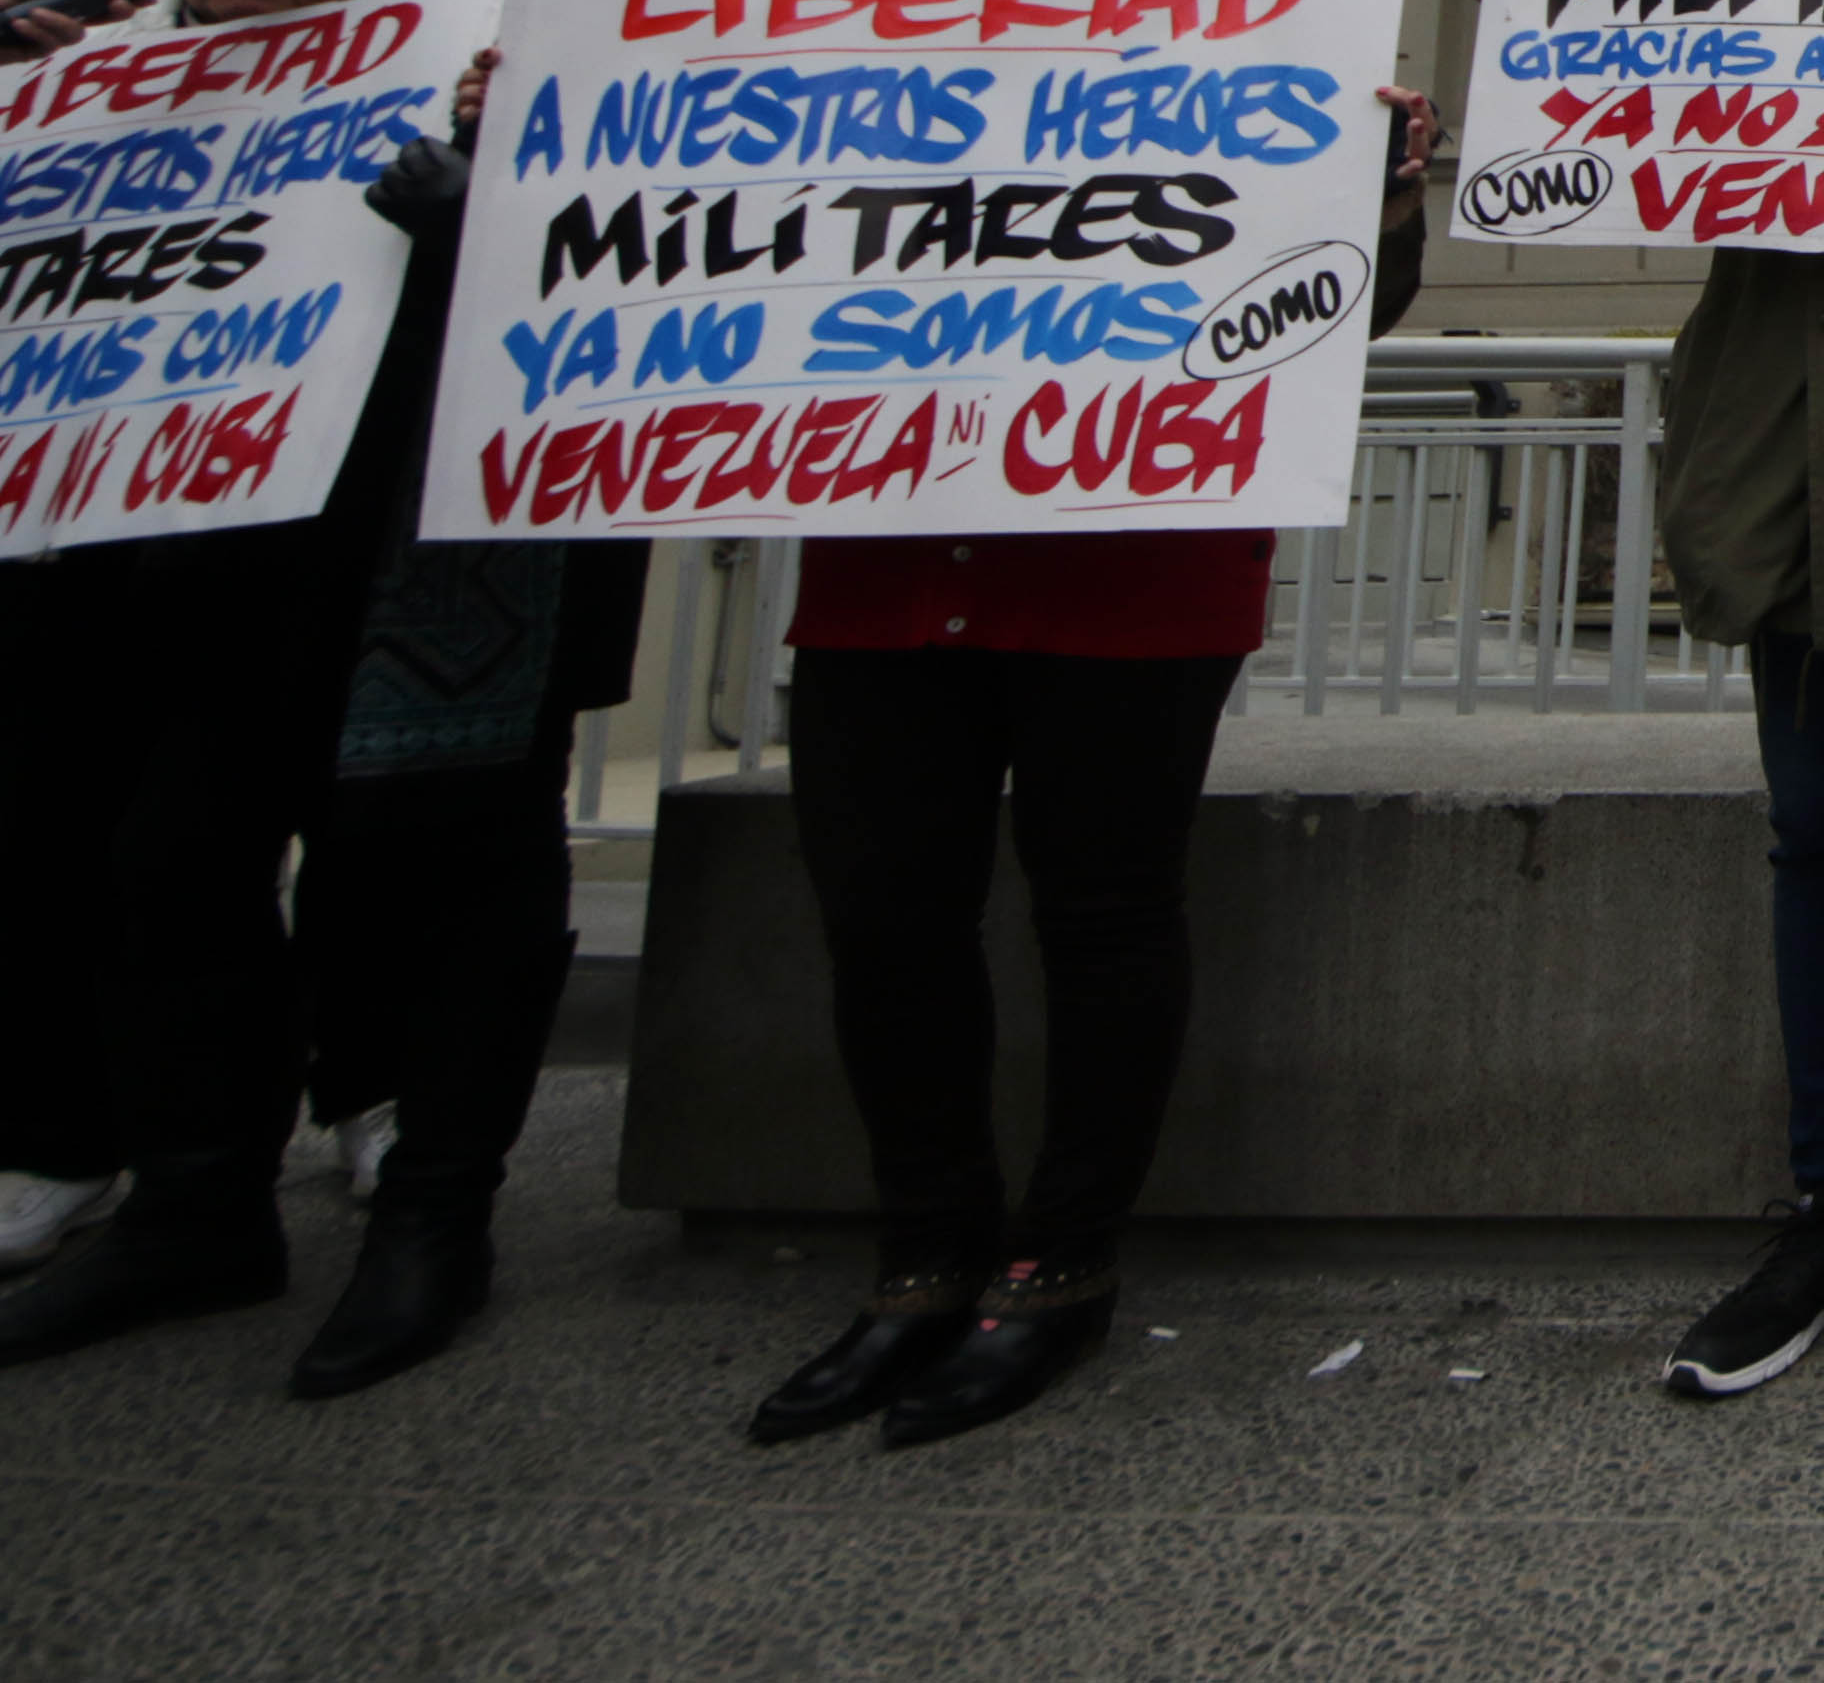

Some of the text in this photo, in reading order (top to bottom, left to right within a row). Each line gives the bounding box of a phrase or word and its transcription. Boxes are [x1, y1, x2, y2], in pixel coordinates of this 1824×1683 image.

[515, 46, 1341, 181] A NUESTROS HÉROES
[1539, 83, 1656, 152] YA
[1674, 87, 1799, 149] NO
[1471, 158, 1599, 226] COMO
[163, 282, 342, 385] COMO
[502, 269, 1342, 413] YA NO SOMOS COMO
[124, 382, 303, 513] CUBA
[480, 389, 939, 526] VENEZUELA
[1003, 375, 1270, 507] CUBA
